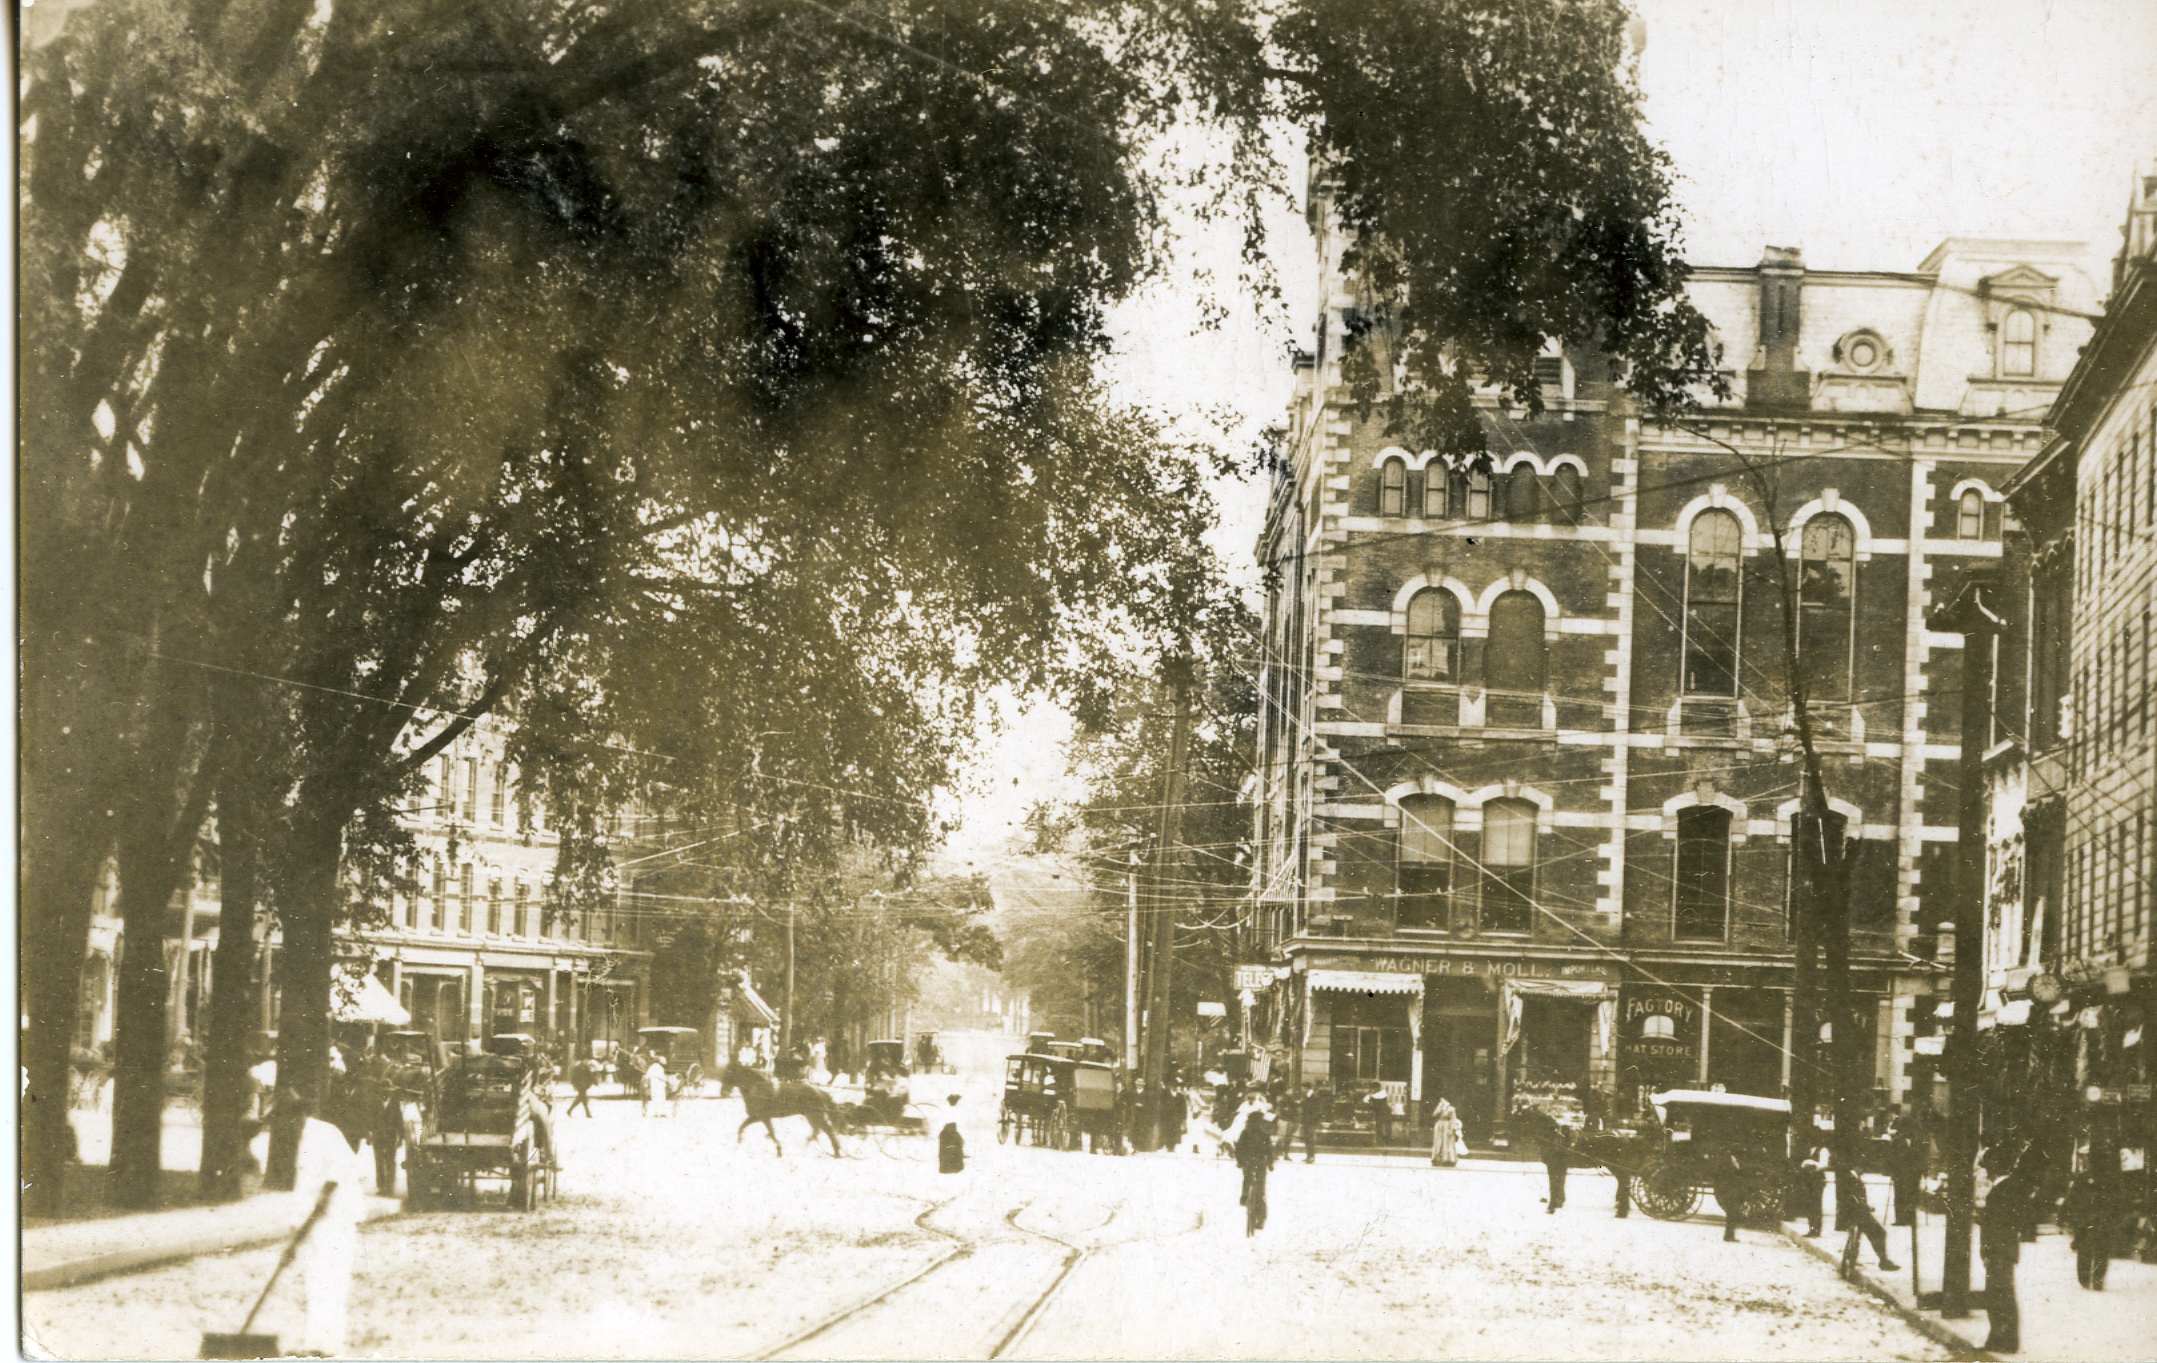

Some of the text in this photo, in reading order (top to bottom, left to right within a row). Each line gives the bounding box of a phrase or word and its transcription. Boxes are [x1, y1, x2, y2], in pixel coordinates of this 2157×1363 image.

[1374, 956, 1452, 975] WAGNER
[1461, 960, 1475, 976] &
[1626, 997, 1694, 1023] FACTORY
[1624, 1044, 1692, 1057] HAT STORE
